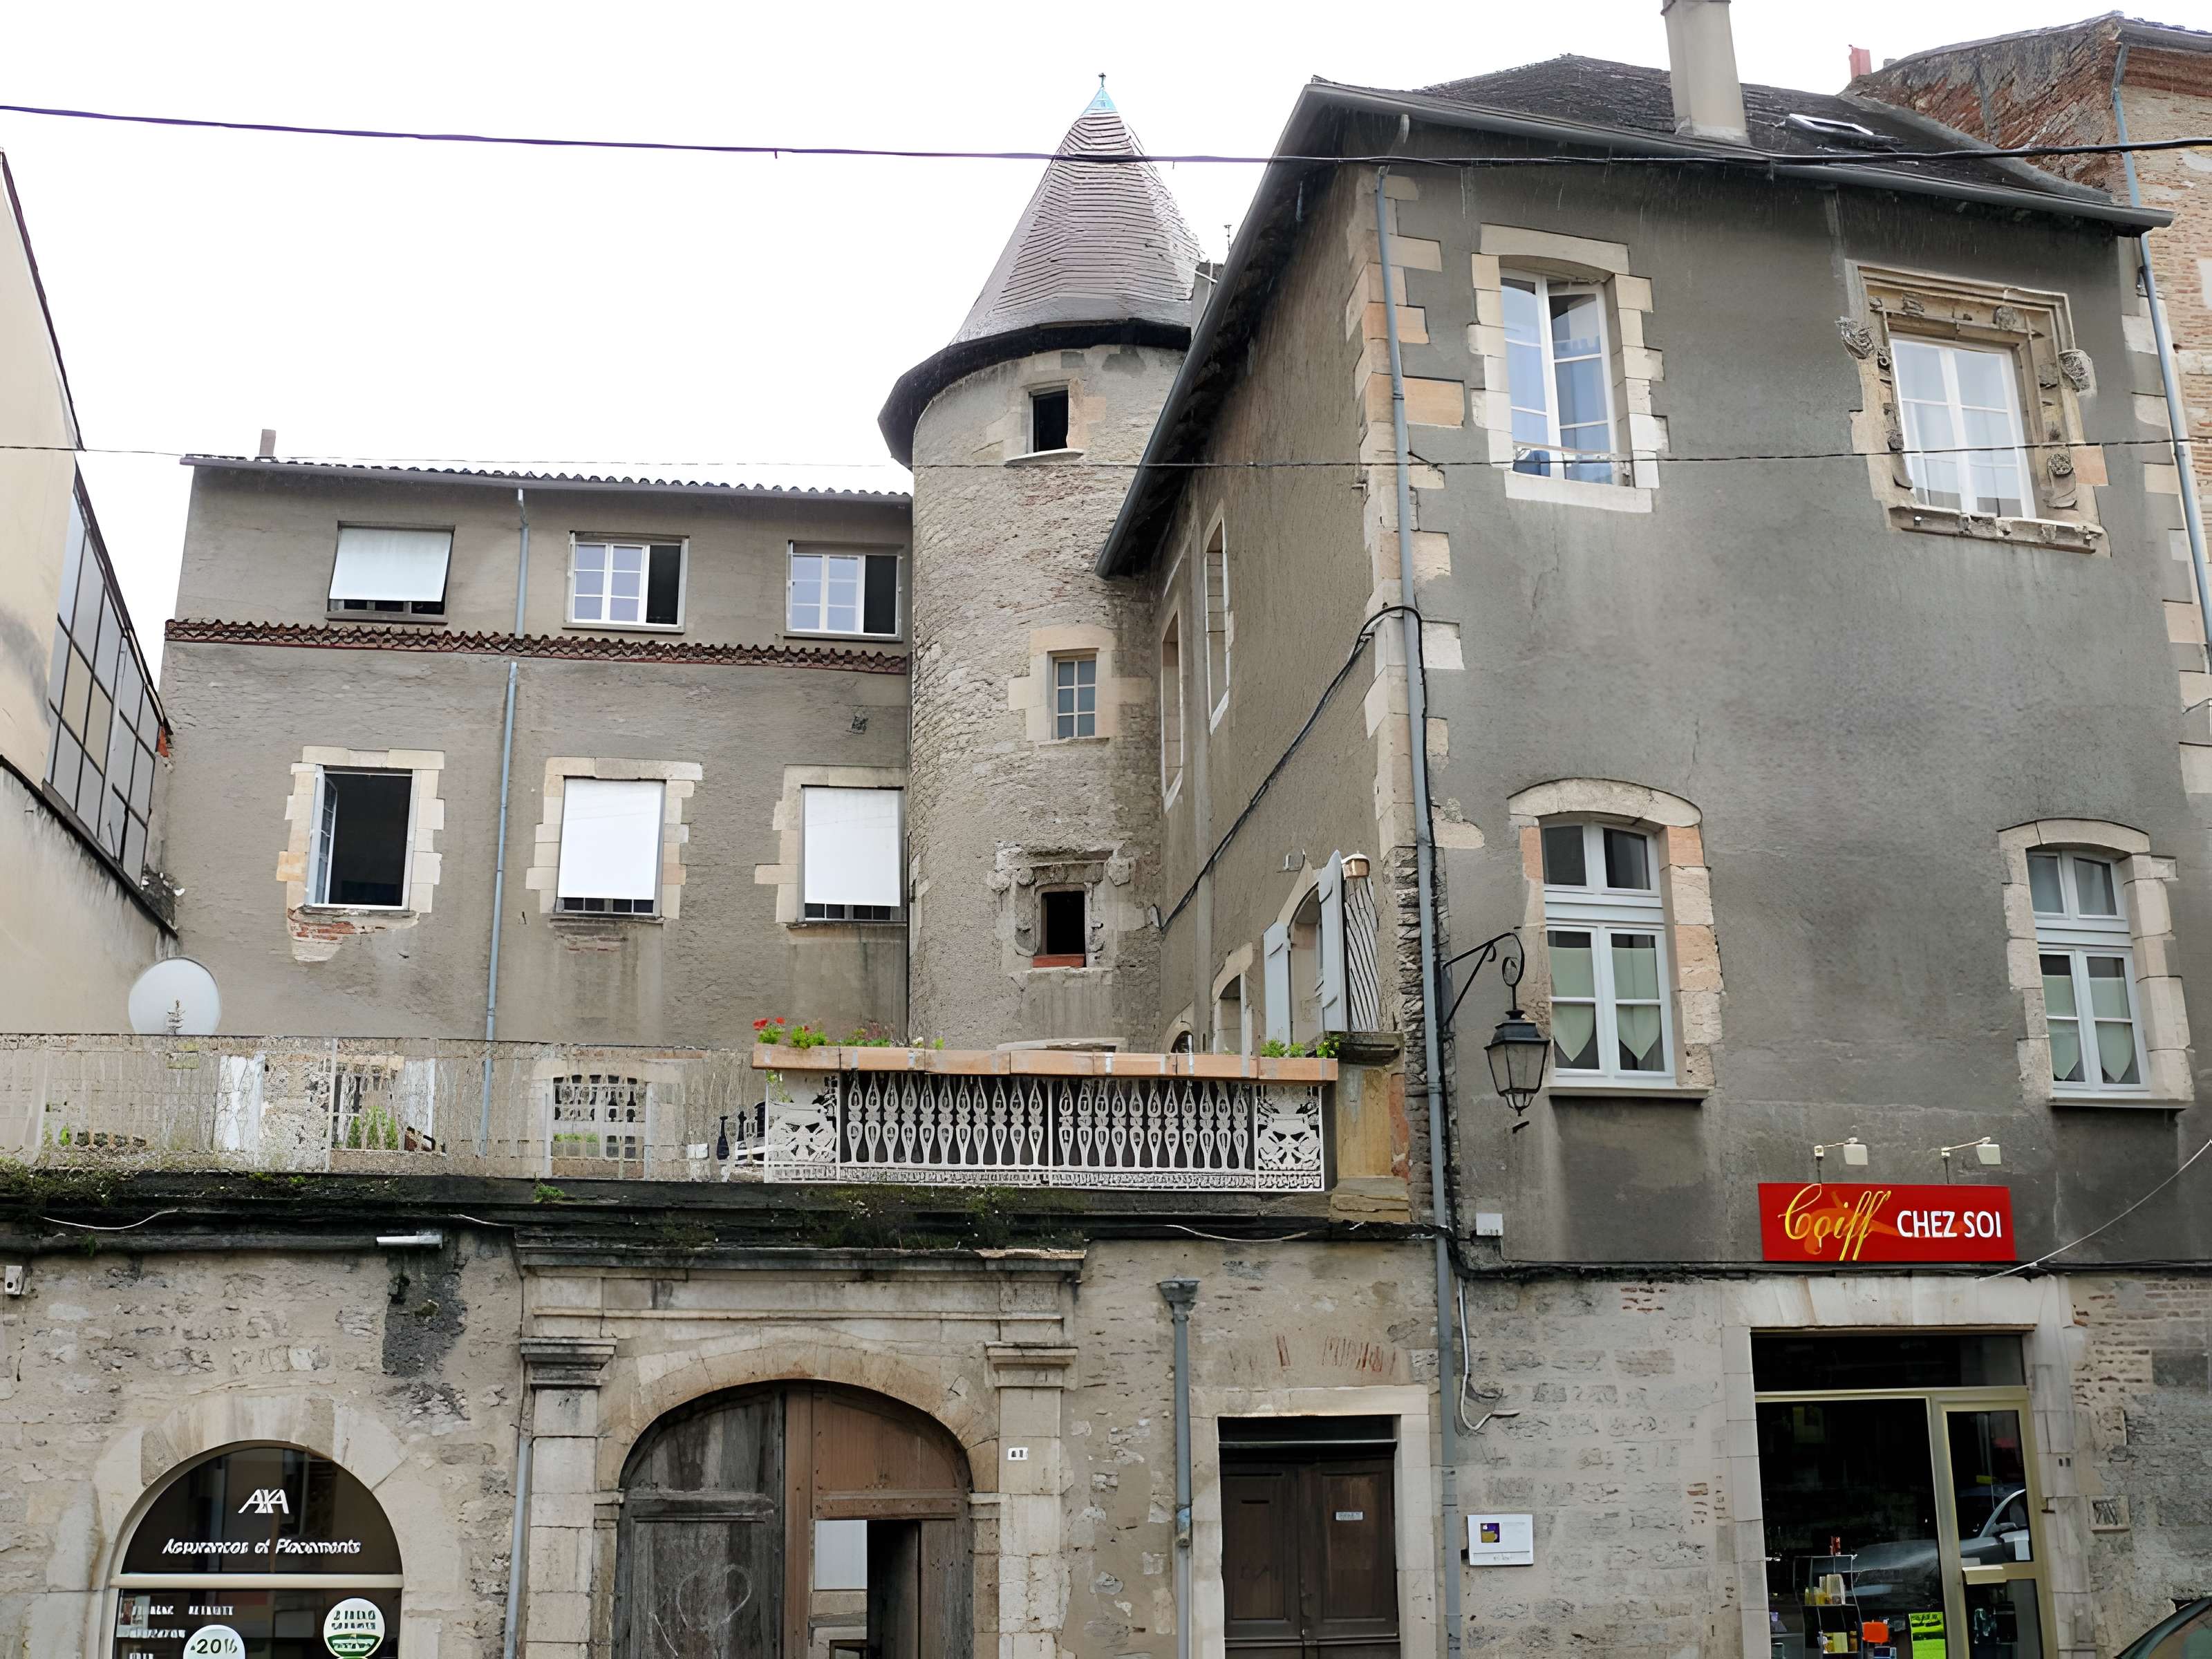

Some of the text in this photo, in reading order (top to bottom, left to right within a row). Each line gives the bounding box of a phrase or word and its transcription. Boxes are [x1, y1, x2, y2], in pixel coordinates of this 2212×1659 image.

[1778, 1183, 2002, 1261] Coiff CHEZ SOI
[238, 1489, 290, 1514] AXA
